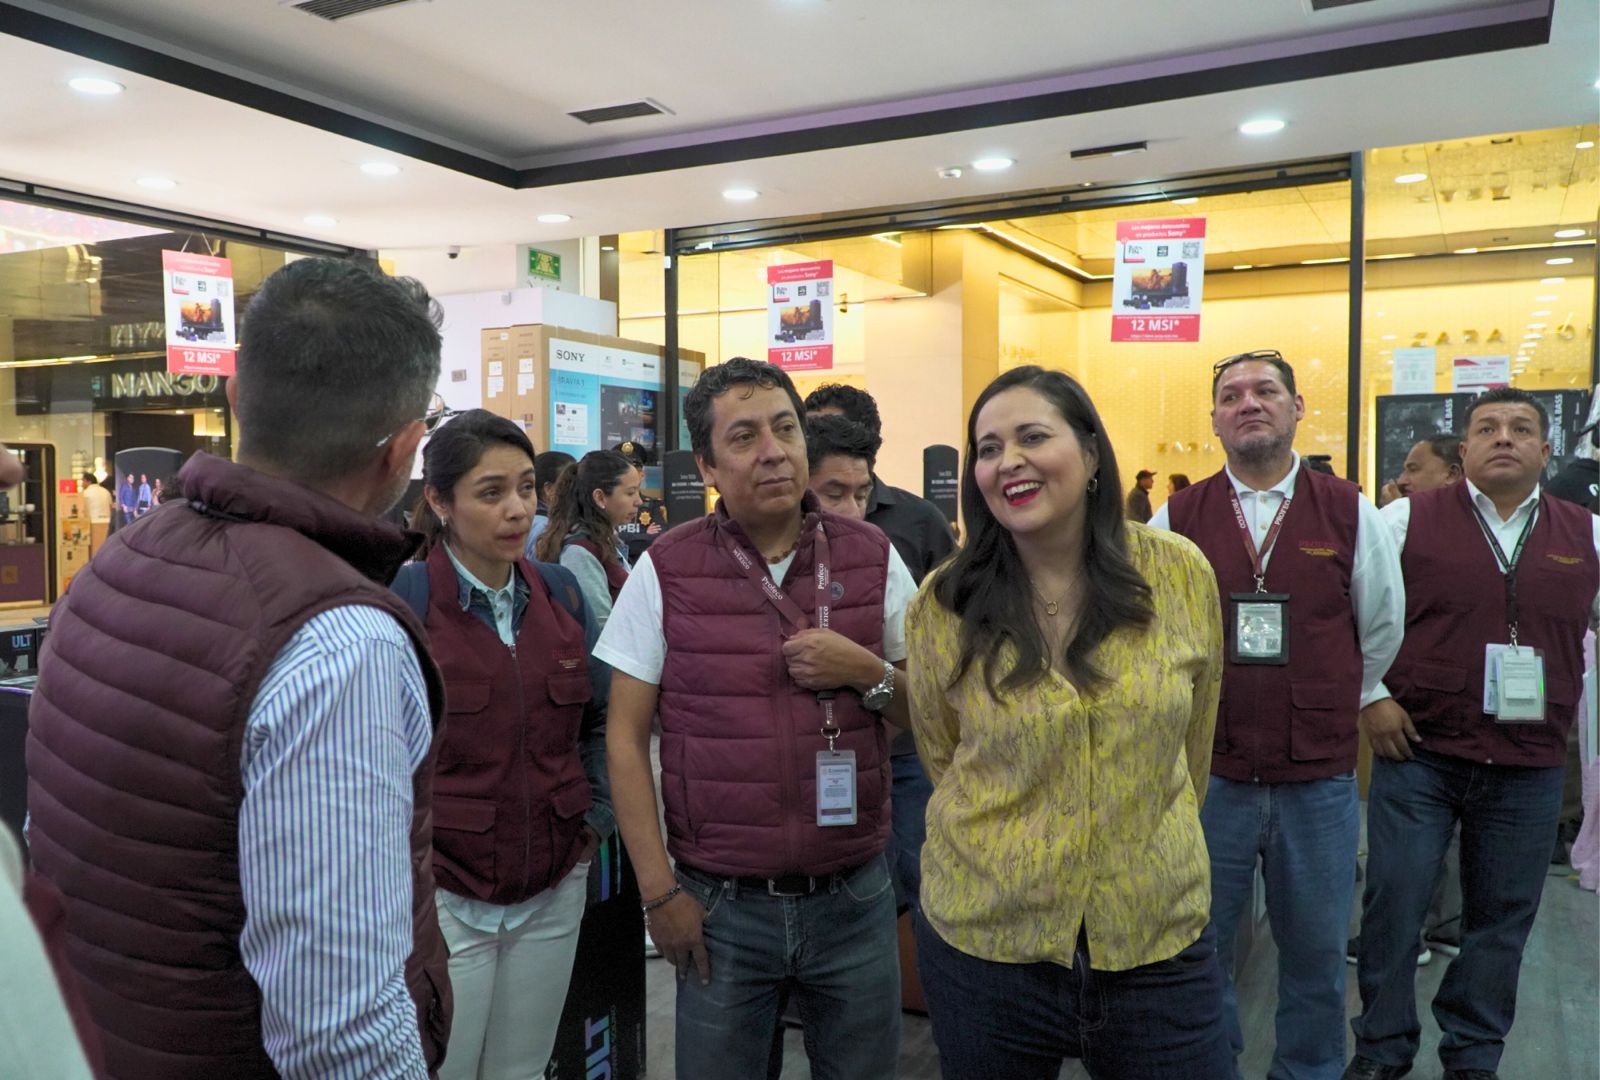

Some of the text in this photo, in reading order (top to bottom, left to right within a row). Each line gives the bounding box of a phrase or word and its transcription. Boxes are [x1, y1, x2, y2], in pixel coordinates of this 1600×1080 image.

[1130, 319, 1145, 331] 12
[183, 351, 195, 363] 12
[556, 349, 585, 362] SONY
[781, 351, 792, 362] 12
[112, 371, 218, 398] MANGO
[1444, 398, 1453, 418] BASS
[1553, 393, 1563, 456] POWERFUL BASS
[1231, 498, 1246, 529] PROFECO
[618, 523, 640, 533] PBI
[732, 548, 750, 570] MÉXICO
[817, 563, 825, 590] Profeco
[762, 576, 783, 600] Profeco
[11, 634, 32, 648] ULT
